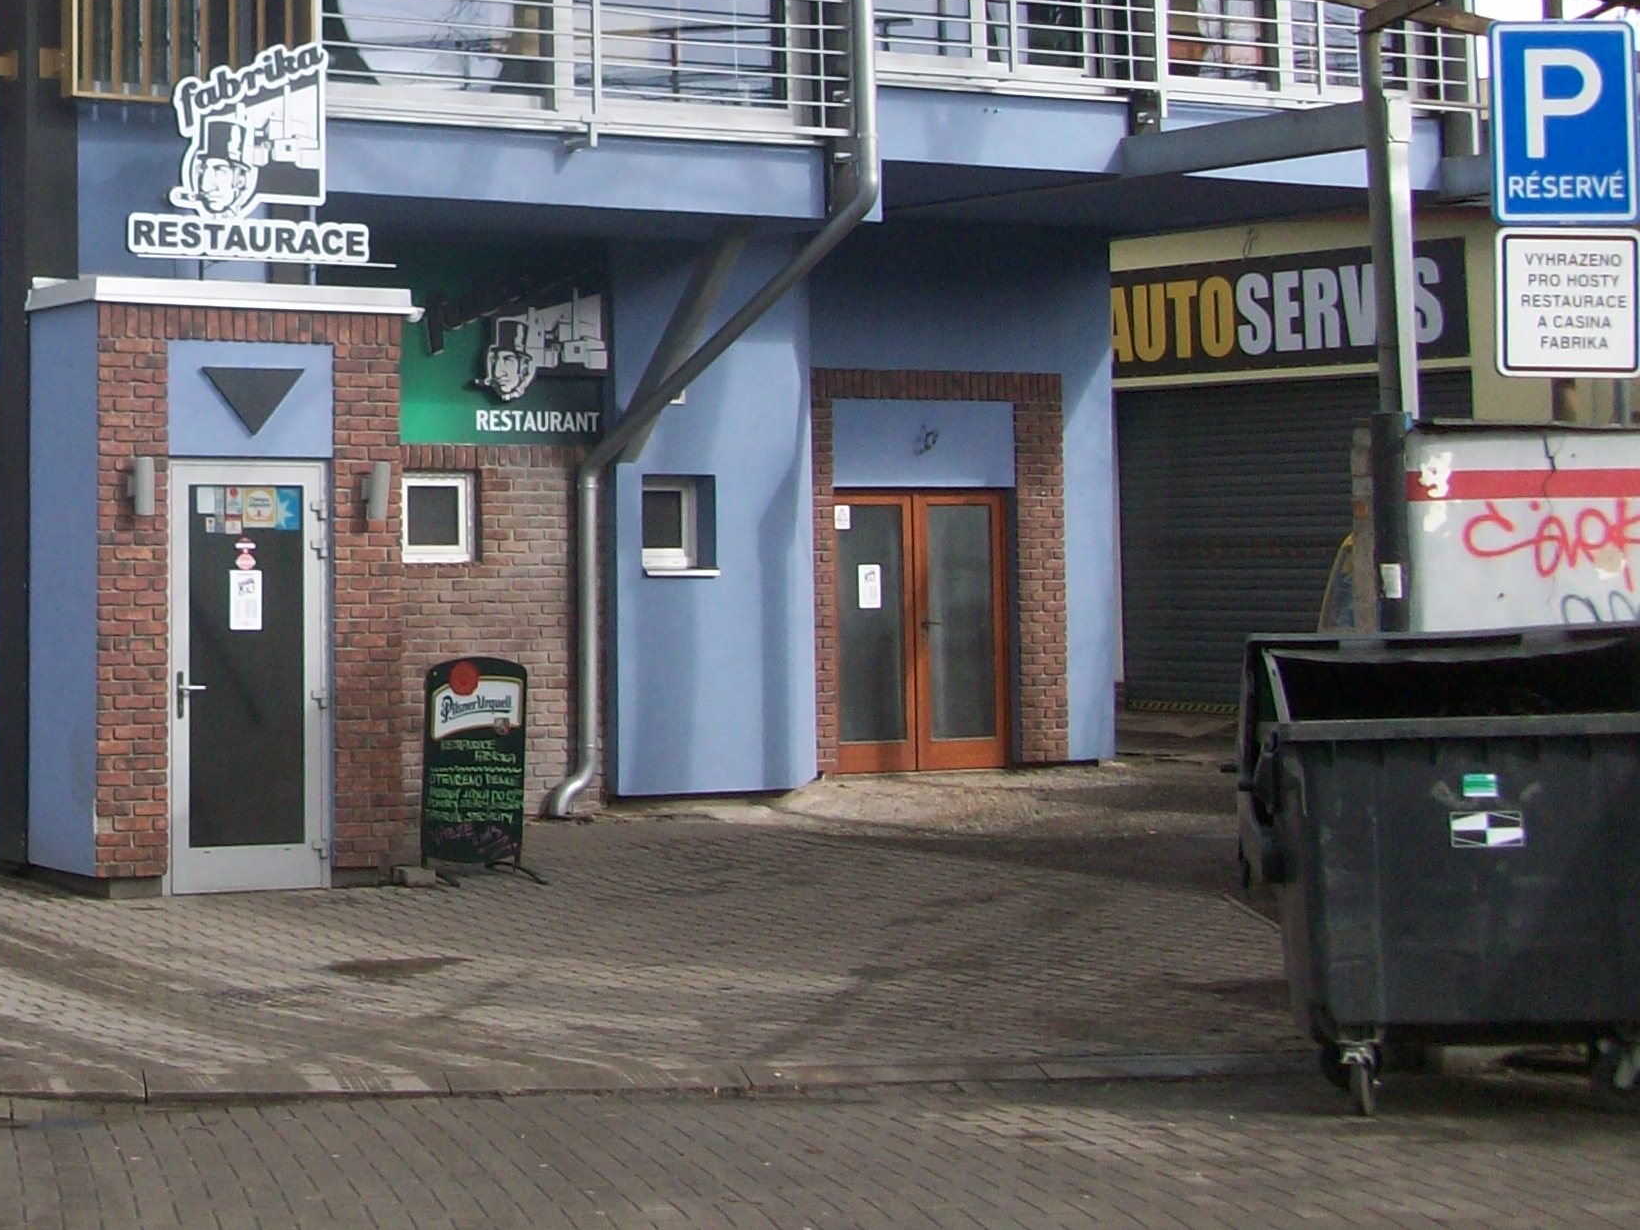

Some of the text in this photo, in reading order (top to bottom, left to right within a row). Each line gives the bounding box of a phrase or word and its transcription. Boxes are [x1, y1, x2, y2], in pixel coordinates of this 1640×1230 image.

[180, 45, 325, 128] fabrika
[1524, 48, 1603, 159] P
[1509, 170, 1626, 199] RÉSERVÉ
[133, 220, 366, 258] RESTAURACE
[1525, 253, 1623, 267] VYHRAZENO
[1528, 273, 1620, 288] PRO HOSTY
[1110, 257, 1444, 364] AUTOSERVS
[1520, 294, 1628, 309] RESTAURACE
[1537, 315, 1612, 329] A CASINA
[1540, 336, 1609, 350] FABRIKA
[475, 409, 601, 433] RESTAURANT
[441, 695, 512, 724] Pilsner Urquell
